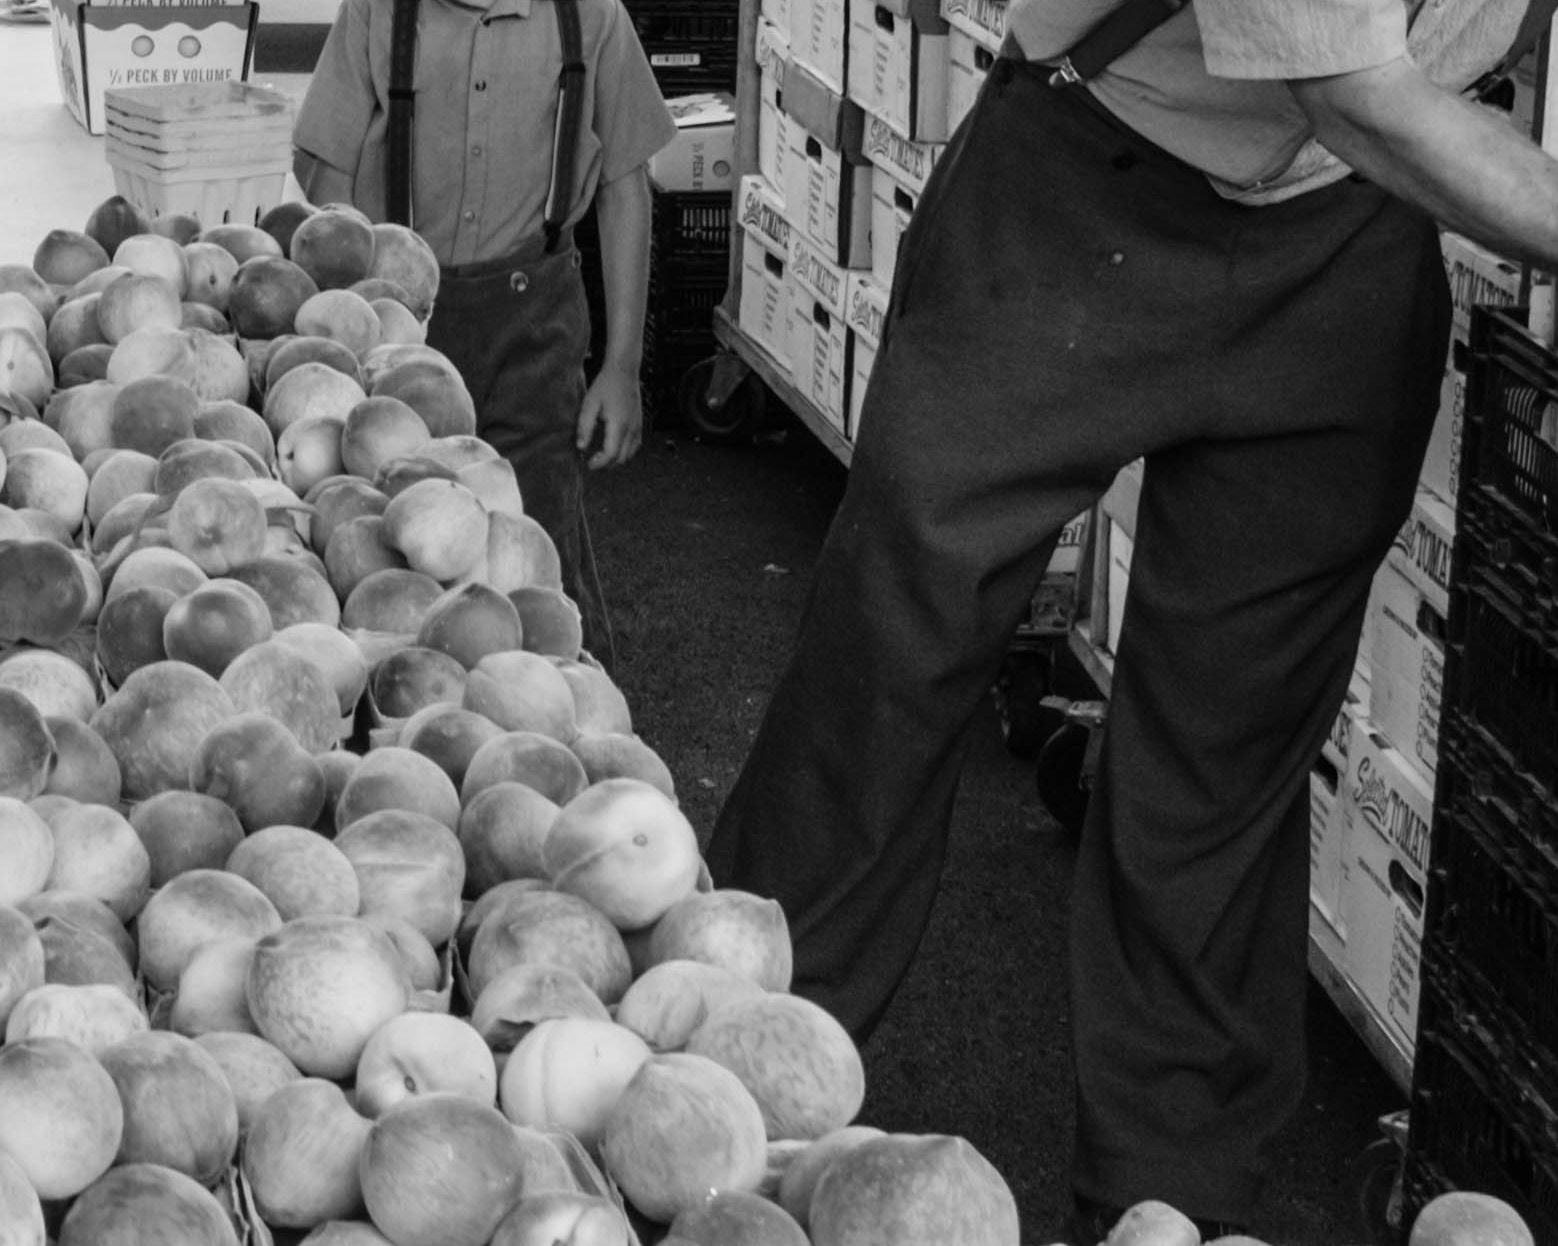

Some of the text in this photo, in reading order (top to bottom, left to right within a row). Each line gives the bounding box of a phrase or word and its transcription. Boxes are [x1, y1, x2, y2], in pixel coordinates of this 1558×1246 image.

[127, 68, 159, 83] PECK
[163, 68, 178, 83] BY
[182, 68, 232, 83] VOLUME
